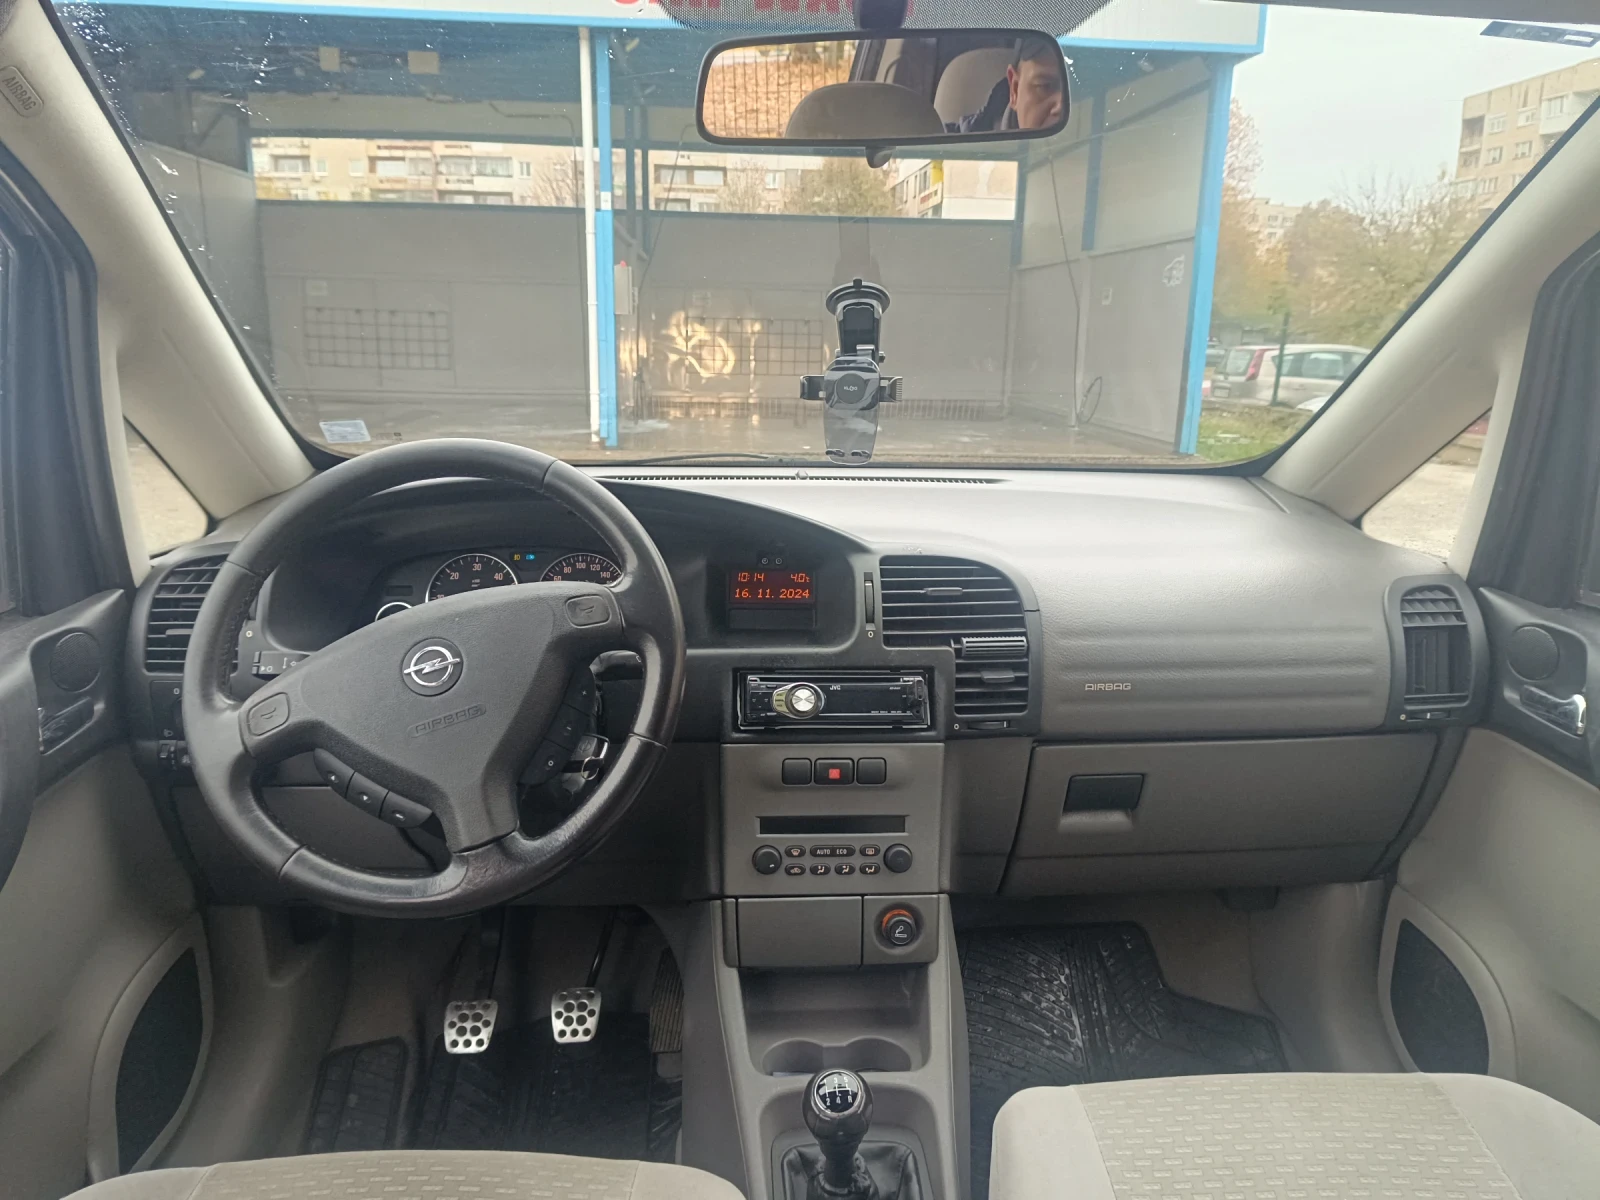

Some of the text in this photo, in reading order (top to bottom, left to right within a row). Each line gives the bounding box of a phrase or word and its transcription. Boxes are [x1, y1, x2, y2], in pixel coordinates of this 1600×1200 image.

[2, 76, 37, 110] AIRBAG
[472, 563, 482, 571] 30
[563, 566, 572, 574] 80
[450, 572, 460, 580] 20
[493, 573, 503, 581] 40
[600, 571, 611, 579] 140
[738, 572, 765, 582] 10:14
[735, 588, 810, 599] 16. 11. 2024
[1085, 682, 1132, 691] AIRBAG
[415, 705, 482, 734] AIRBAG
[826, 1095, 852, 1106] 2 4 R
